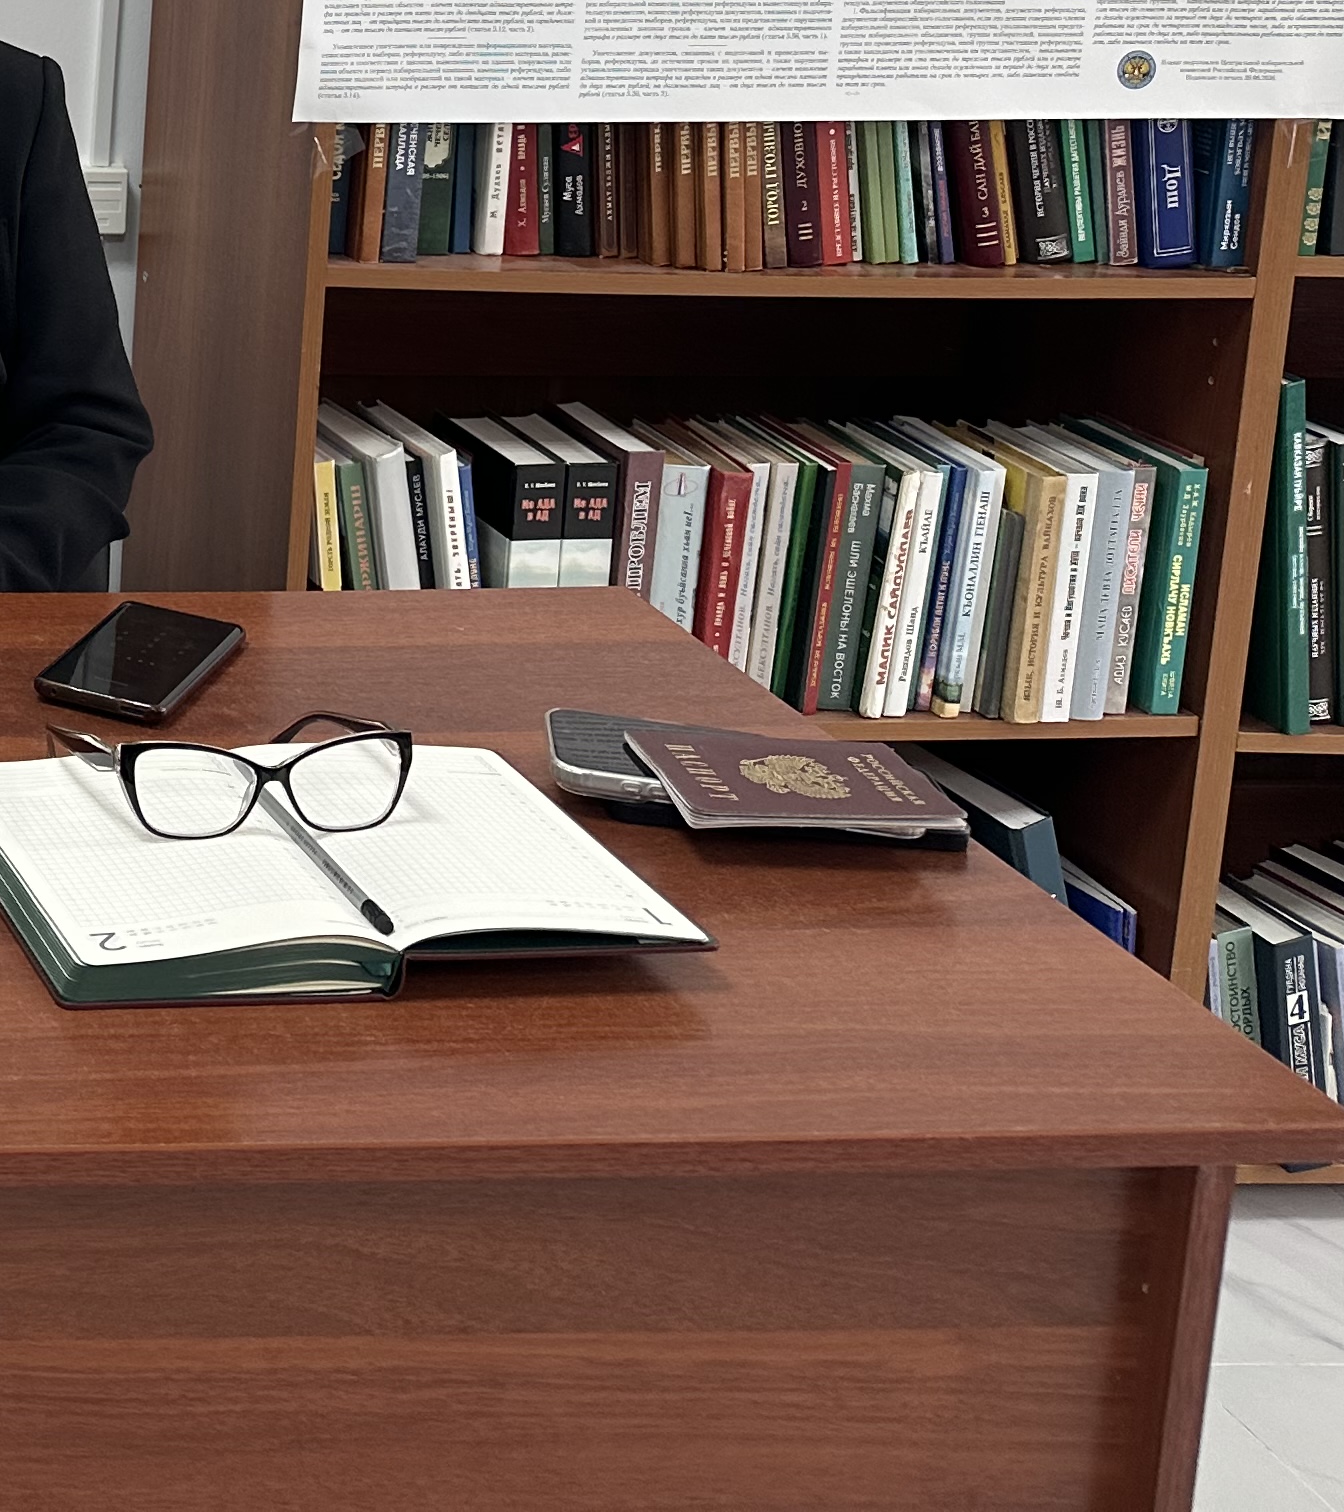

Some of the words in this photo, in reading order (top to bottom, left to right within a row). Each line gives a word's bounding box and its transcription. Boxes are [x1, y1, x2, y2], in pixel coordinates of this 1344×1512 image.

[1110, 125, 1127, 168] ЖИЗНЬ
[765, 181, 780, 226] ГОРОД
[412, 474, 424, 516] МУСАЕВ
[1129, 481, 1149, 522] ЧЕЧНИ
[417, 519, 429, 561] АЛАУДИ
[625, 480, 652, 590] ПРОБЛЕМ
[1041, 495, 1057, 551] ВАЙНАХОВ
[849, 540, 862, 568] ШЛИ
[1121, 529, 1142, 595] ПИСАТЕЛИ
[839, 570, 858, 631] ЭШЕЛОНЫ
[961, 541, 983, 618] КЪОНАЛЛИН
[1034, 555, 1049, 608] КУЛЬТУРА
[1165, 554, 1183, 604] СИРЛАЧУ
[1117, 605, 1133, 647] КУСАЕВ
[1174, 583, 1191, 637] ИСЛАМАН
[836, 633, 847, 650] НА
[875, 624, 895, 686] МАЛИК
[1026, 623, 1041, 667] ИСТОРИЯ
[1160, 605, 1176, 665] НОВКЪАХЬ
[829, 652, 845, 699] ВОСТОК
[1113, 655, 1127, 685] АДИЗ
[664, 743, 740, 802] ПАСПОРТ
[846, 756, 903, 802] ФЕДЕРАЦИЯ
[859, 753, 927, 806] РОССИЙСКАЯ
[1289, 993, 1307, 1021] 4
